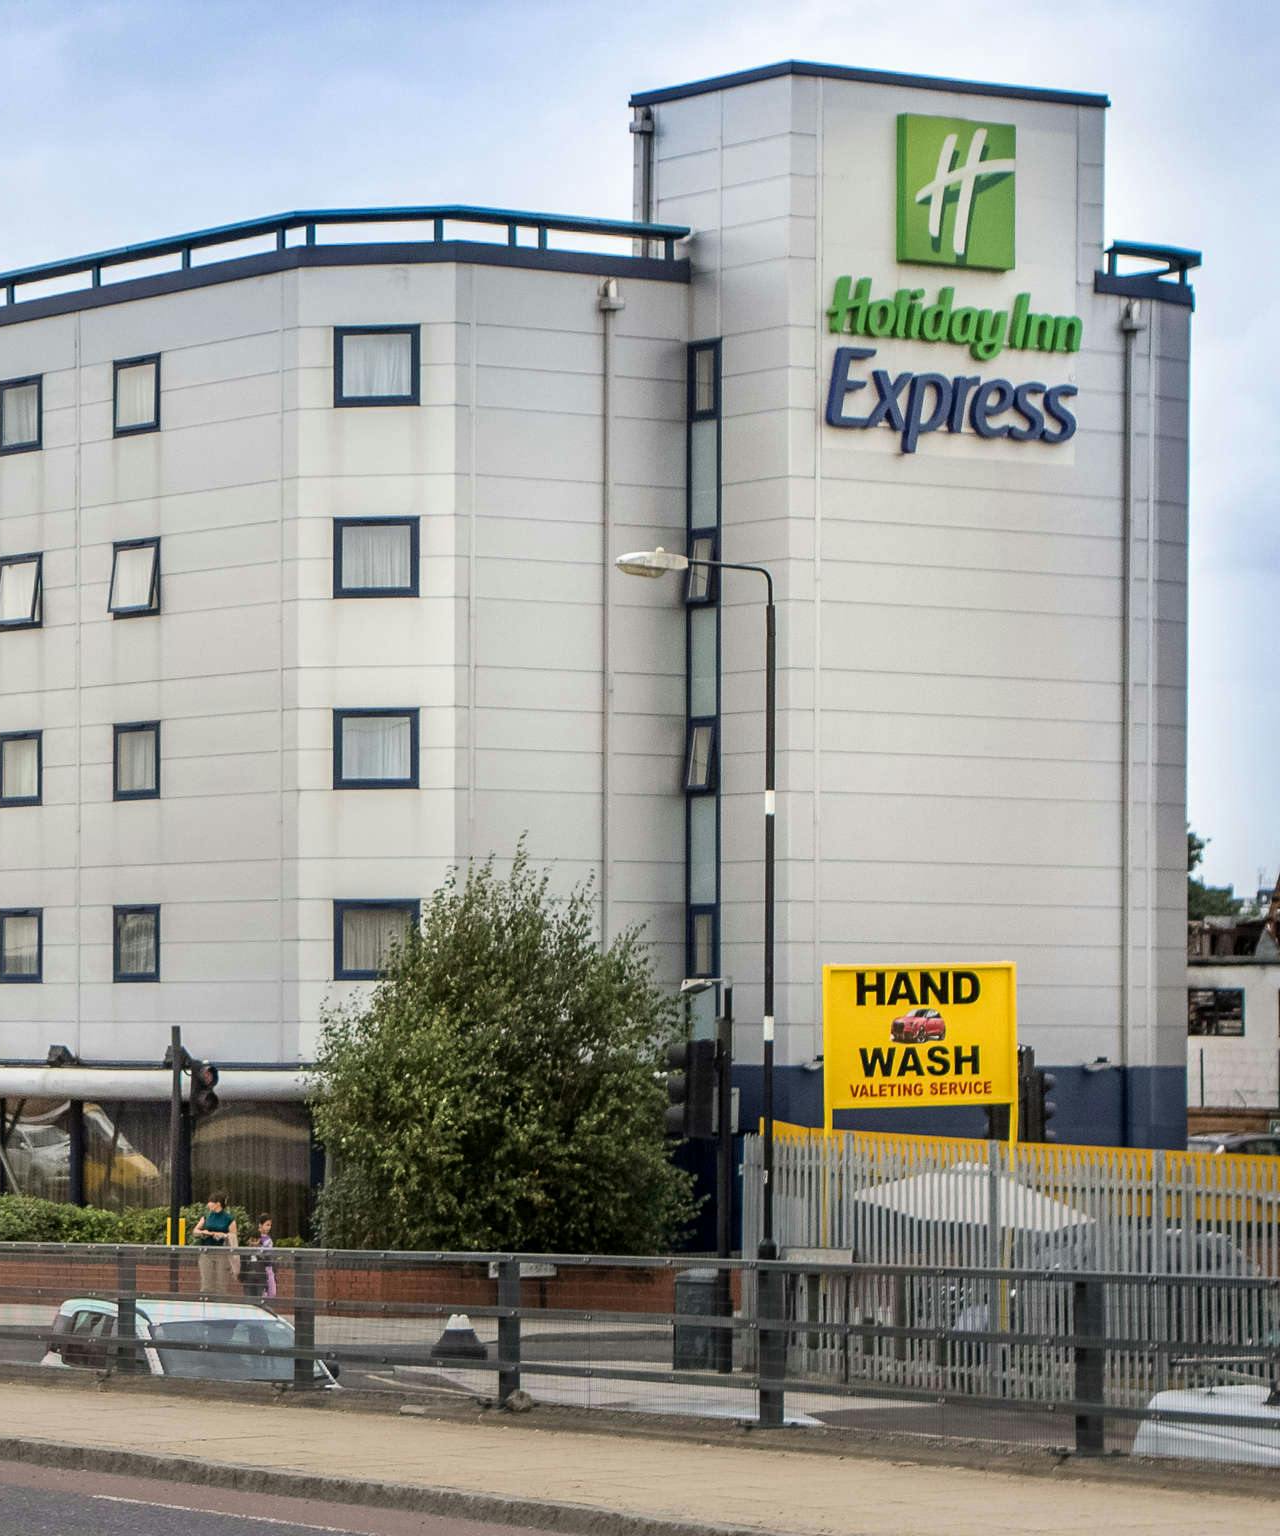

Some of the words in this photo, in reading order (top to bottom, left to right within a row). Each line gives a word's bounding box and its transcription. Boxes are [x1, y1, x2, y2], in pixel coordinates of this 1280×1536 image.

[826, 275, 1008, 360] Holiday
[1009, 292, 1083, 353] Inn
[825, 346, 1079, 453] Express
[855, 971, 981, 1006] HAND
[859, 1045, 980, 1078] WASH
[850, 1083, 923, 1098] VALETING
[930, 1081, 992, 1096] SERVICE
